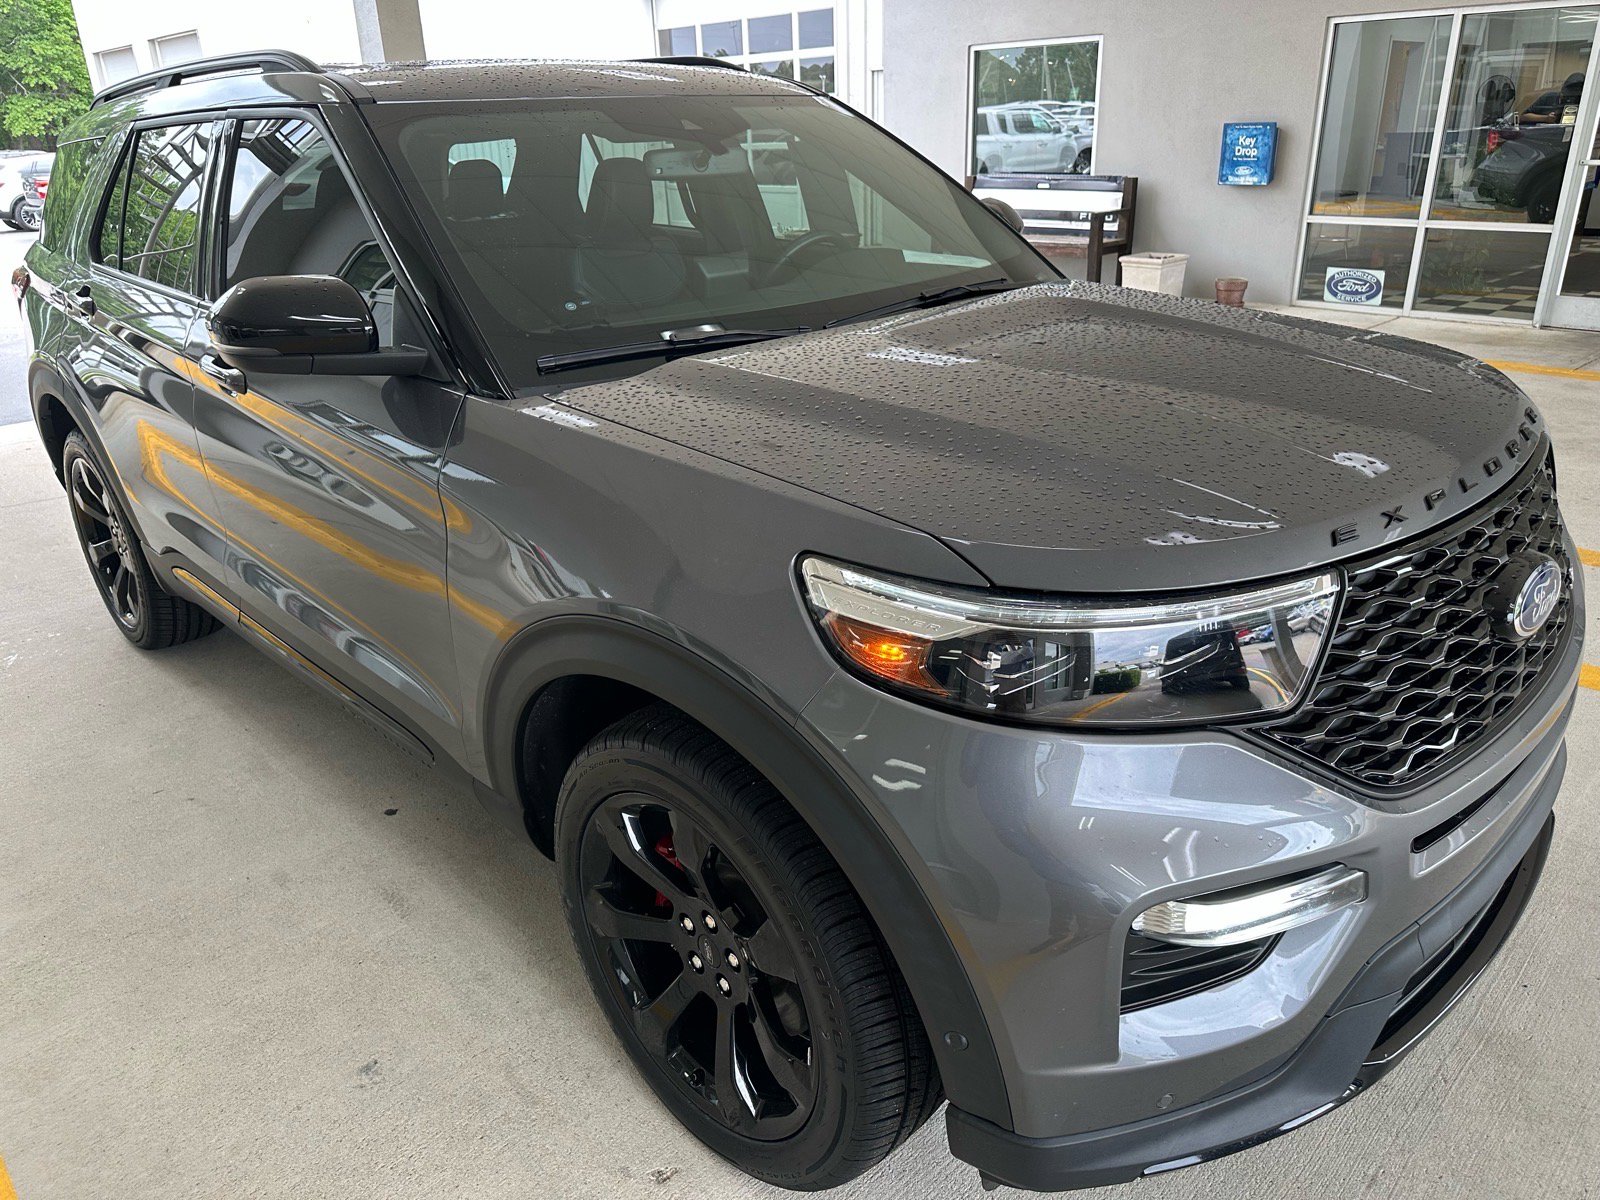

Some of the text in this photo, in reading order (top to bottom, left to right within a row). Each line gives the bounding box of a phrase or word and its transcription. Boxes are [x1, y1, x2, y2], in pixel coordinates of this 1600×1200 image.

[1238, 135, 1256, 147] Key
[1235, 146, 1258, 158] Drop
[1079, 212, 1114, 221] FD
[1334, 270, 1377, 283] AUTHORIZED
[1337, 279, 1370, 292] Ford
[1337, 294, 1367, 303] SERVICE
[1330, 406, 1539, 547] EXPLORER
[1532, 577, 1557, 623] Ford
[831, 597, 942, 632] EXPLORER
